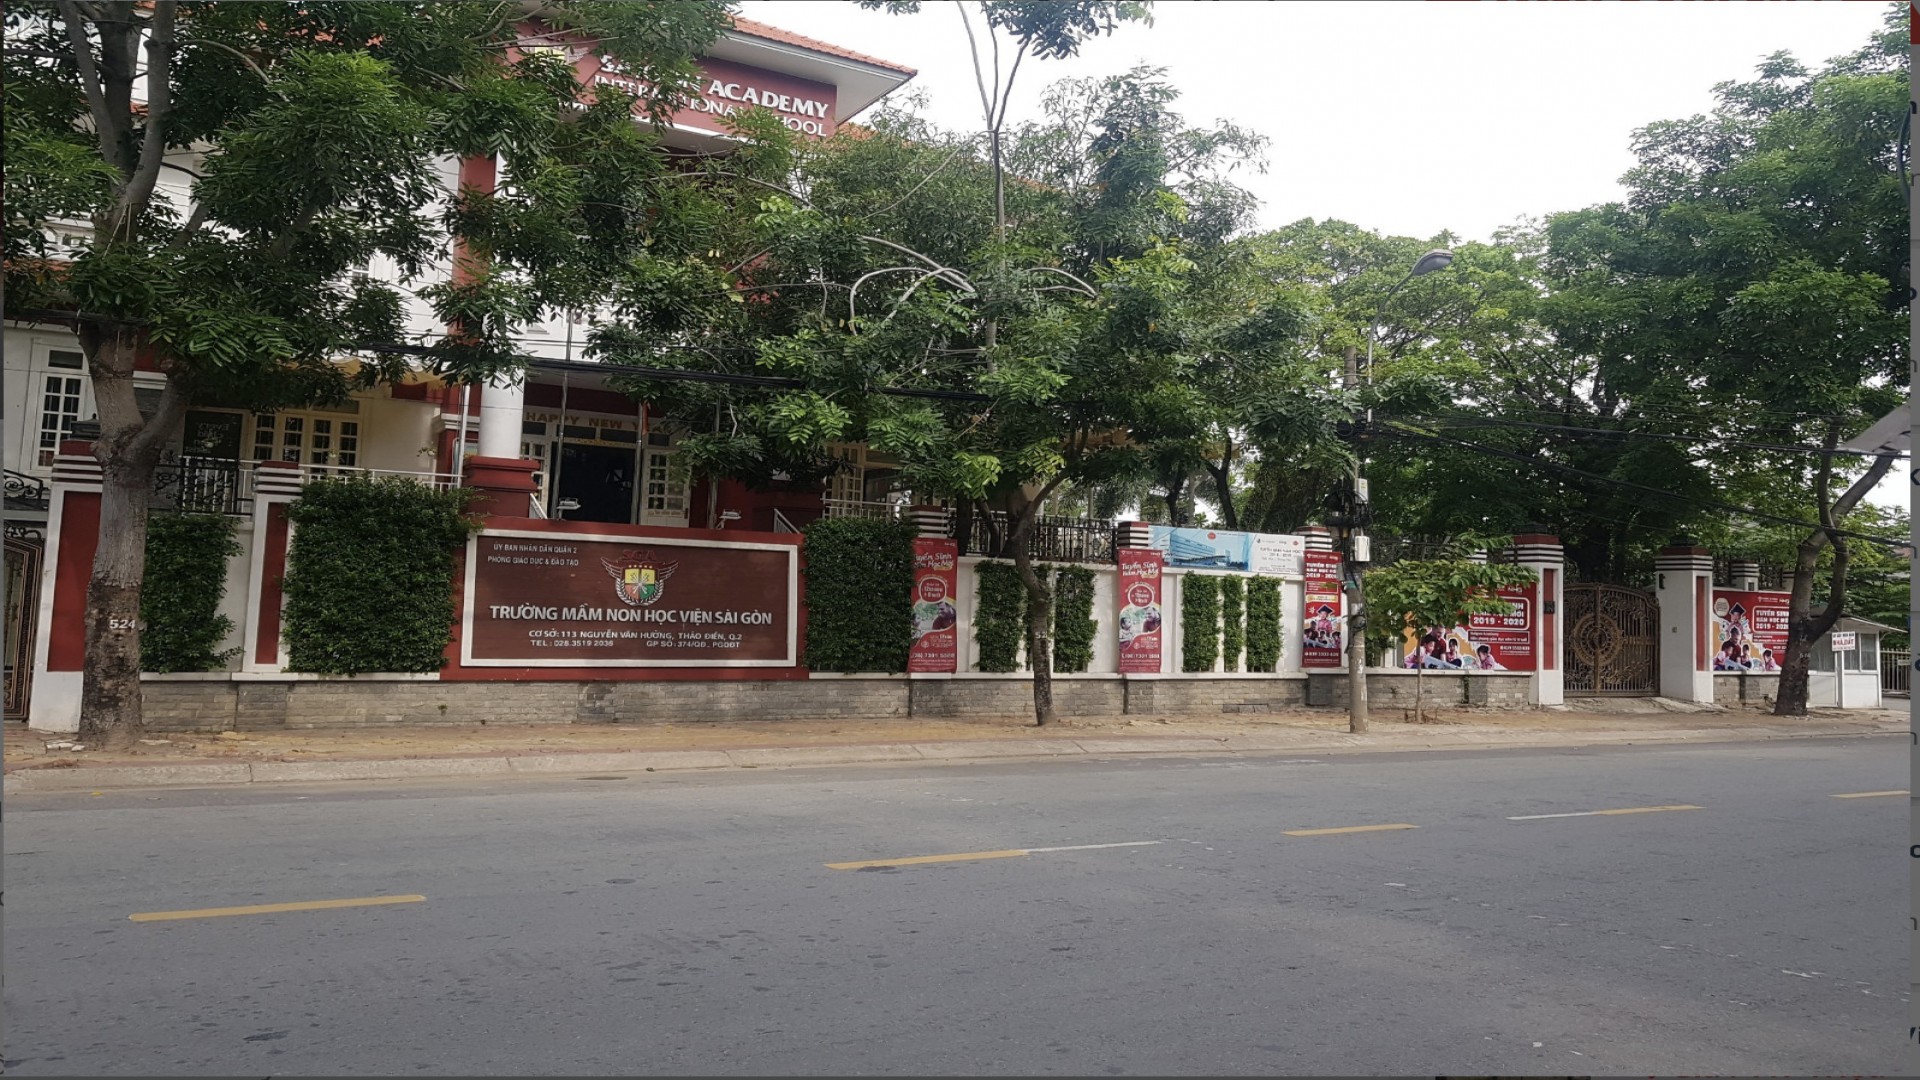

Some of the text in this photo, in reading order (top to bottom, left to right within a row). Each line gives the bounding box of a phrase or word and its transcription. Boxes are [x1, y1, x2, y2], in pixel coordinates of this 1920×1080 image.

[709, 80, 829, 118] ACADEMY
[588, 418, 623, 429] NEW
[504, 543, 518, 552] BAN
[490, 602, 772, 626] TRƯỜNG MẦM NON HỌC VIỆN SÀI GÒN
[109, 619, 136, 629] 524
[1473, 617, 1495, 625] 2019
[528, 630, 543, 638] CƠ
[561, 630, 577, 638] 113
